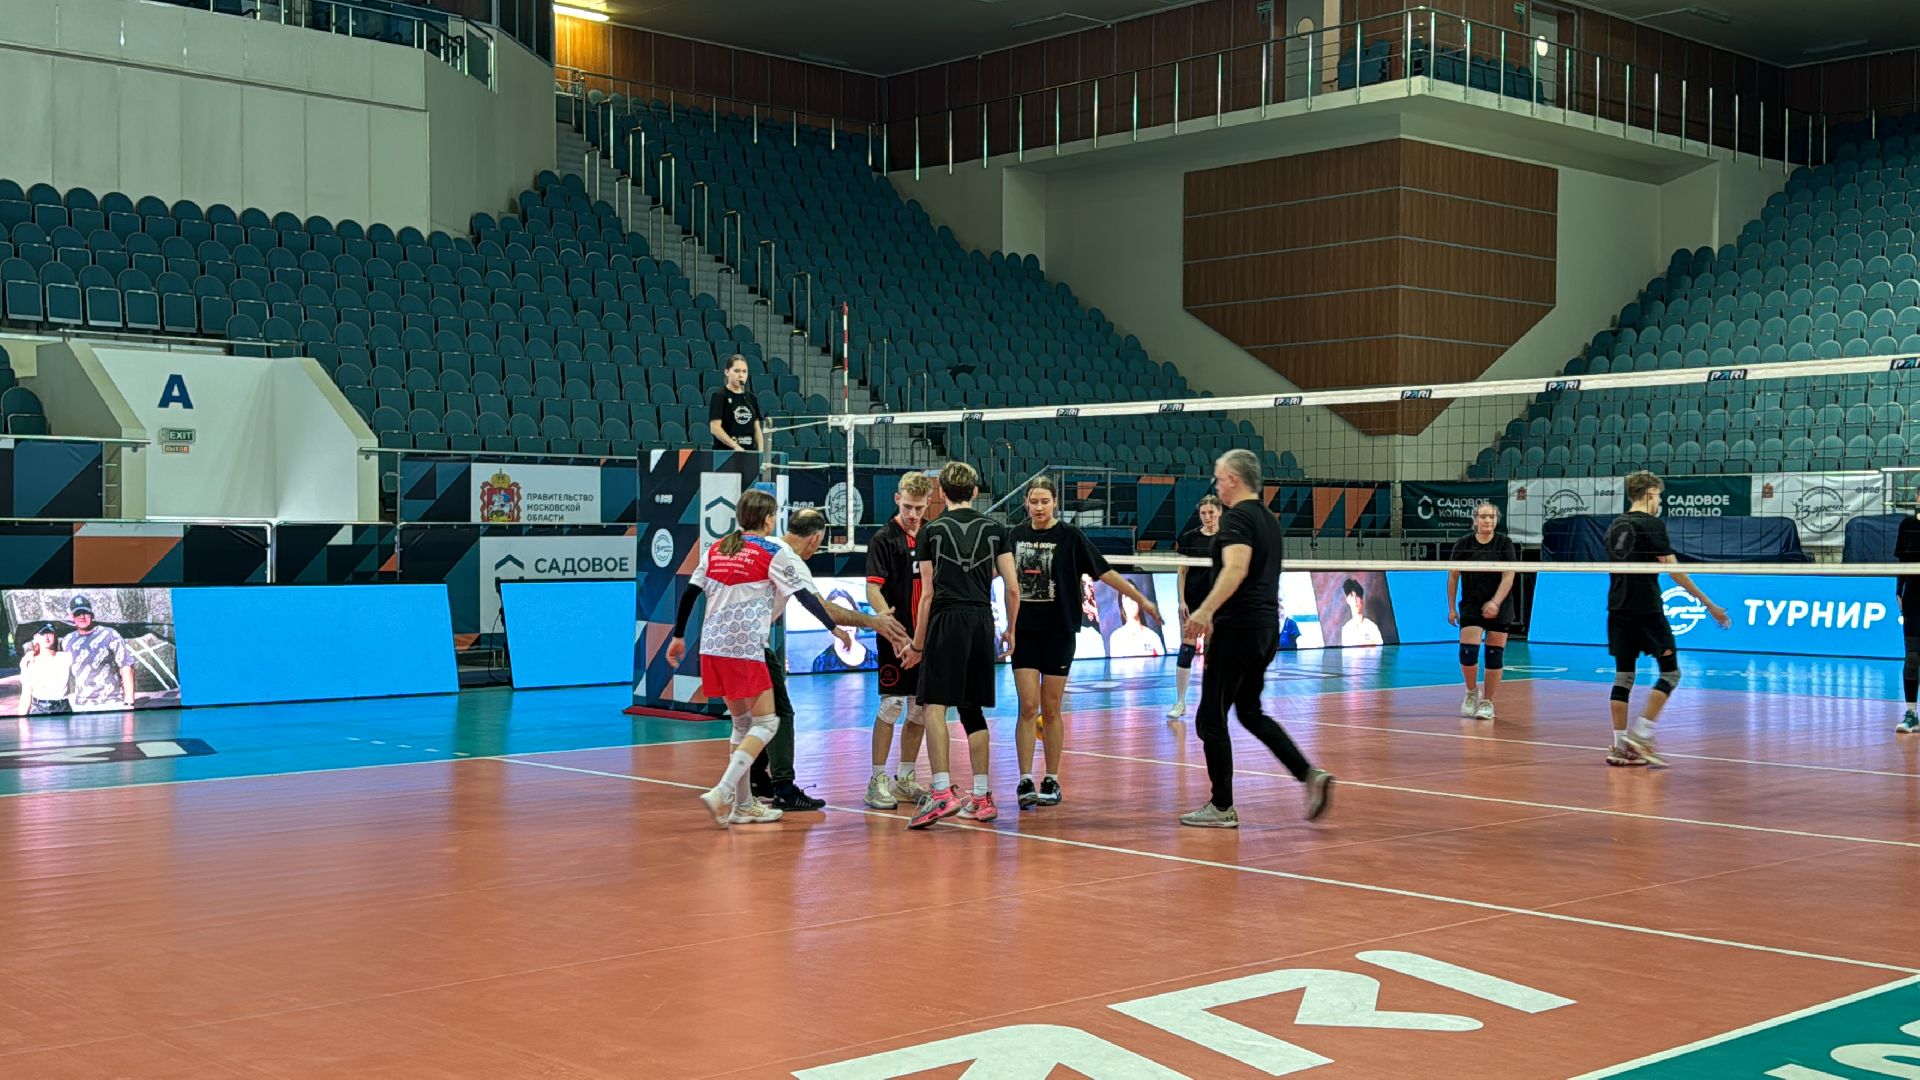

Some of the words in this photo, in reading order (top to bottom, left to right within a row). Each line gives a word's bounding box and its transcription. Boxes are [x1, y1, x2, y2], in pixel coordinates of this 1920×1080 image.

[1709, 369, 1746, 381] PARI
[1547, 380, 1580, 392] PARI
[1402, 390, 1431, 399] PARI
[1275, 397, 1301, 406] PARI
[1160, 404, 1184, 412] PARI
[963, 413, 983, 421] PARI
[169, 431, 192, 440] EXIT
[526, 493, 594, 502] ПРАВИТЕЛЬСТВО
[1667, 494, 1730, 507] САДОВОЕ
[526, 502, 581, 512] МОСКОВСКОЙ
[526, 513, 564, 522] ОБЛАСТИ
[1438, 508, 1478, 518] КОЛЬЦ
[1667, 507, 1722, 518] КОЛЬЦО
[534, 557, 629, 576] САДОВОЕ
[1743, 598, 1887, 630] ТУРНИР
